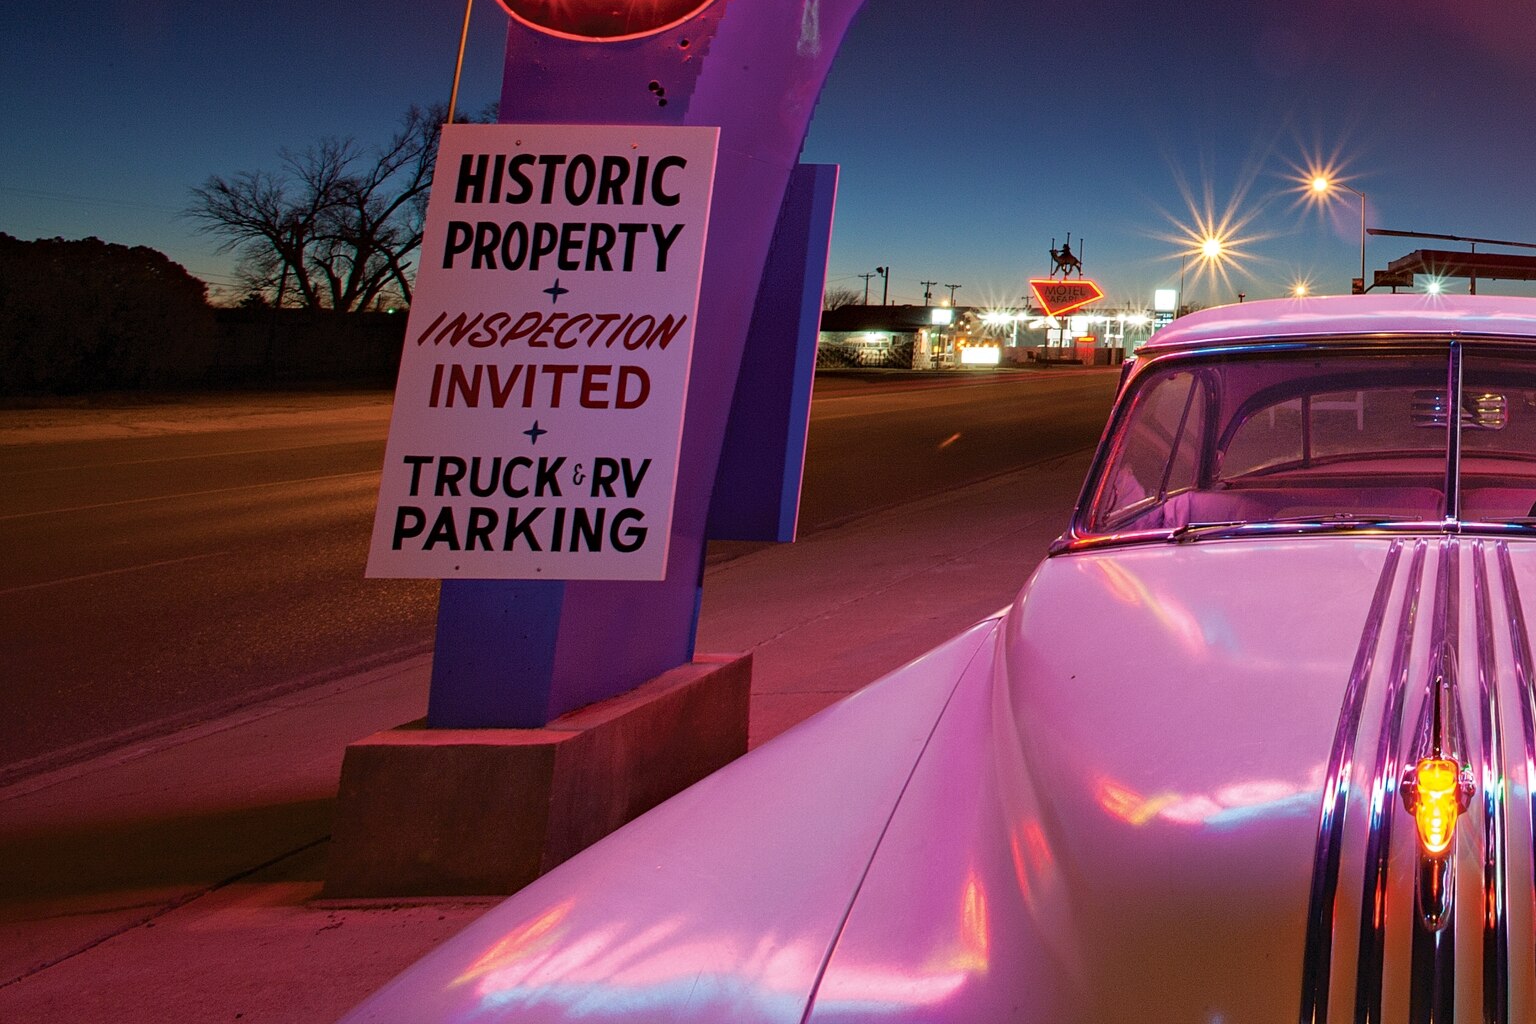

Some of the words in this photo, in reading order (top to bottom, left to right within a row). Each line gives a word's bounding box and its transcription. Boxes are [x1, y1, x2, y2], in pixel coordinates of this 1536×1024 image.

[454, 153, 688, 207] HISTORIC
[442, 220, 686, 272] PROPERTY
[1045, 285, 1086, 296] MOTEL
[1047, 295, 1077, 304] AFARI
[417, 311, 688, 351] INSPECTION
[428, 363, 651, 410] INVITED
[403, 455, 568, 498] TRUCK
[573, 463, 586, 487] &
[590, 457, 653, 499] RV
[392, 505, 649, 554] PARKING
